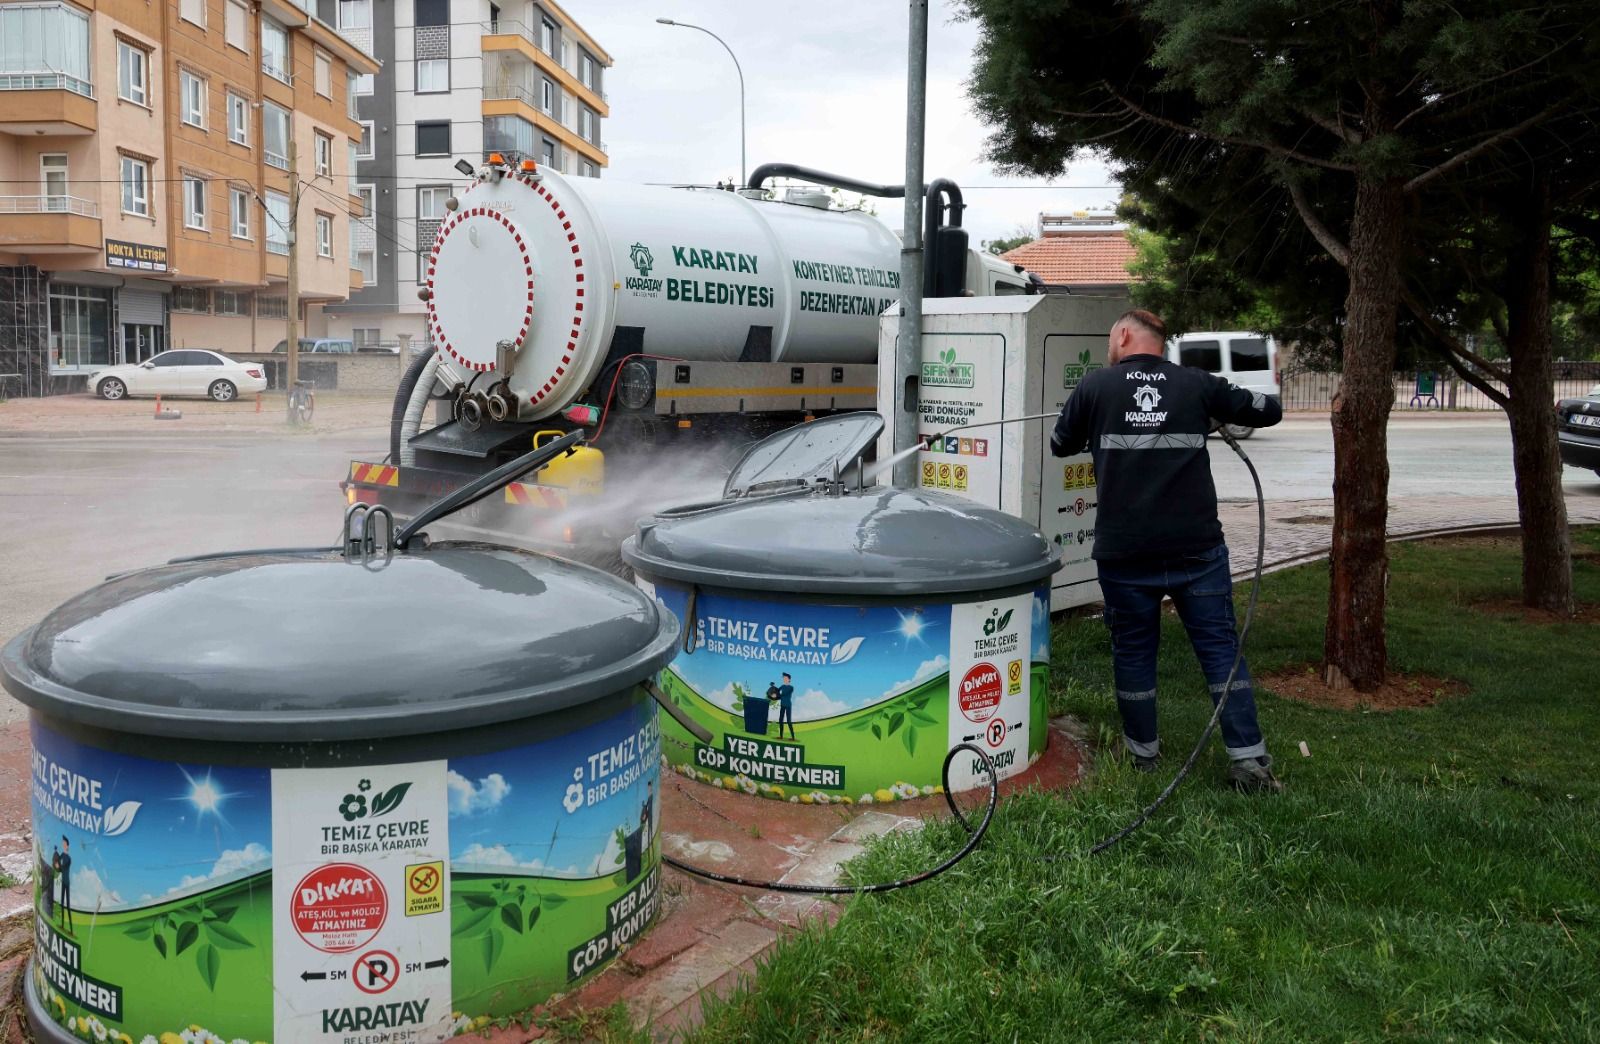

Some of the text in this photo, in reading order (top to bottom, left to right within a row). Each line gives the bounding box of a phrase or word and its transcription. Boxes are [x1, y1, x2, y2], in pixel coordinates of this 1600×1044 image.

[108, 243, 134, 258] NOKTA
[672, 245, 758, 275] KARATAY
[792, 259, 855, 285] KONTEYNER
[625, 276, 663, 292] KARATAY
[800, 290, 875, 316] DEZENFEKTAN
[1126, 371, 1167, 381] KONYA
[924, 414, 969, 425] KUMBARASI
[1125, 411, 1168, 422] KARATAY
[764, 624, 830, 648] ÇEVRE
[727, 643, 767, 661] BAŞKA
[770, 648, 829, 665] KARATAY
[698, 747, 726, 768] ÇÖP
[727, 736, 801, 763] YER ALTI
[49, 762, 103, 811] ÇEVRE
[610, 762, 641, 796] BAŞKA
[53, 798, 102, 835] KARATAY
[376, 819, 429, 842] ÇEVRE
[342, 842, 379, 855] BAŞKA
[382, 837, 429, 851] KARATAY
[610, 865, 657, 925] YER ALTI
[351, 906, 381, 917] MOLOZ
[408, 902, 440, 912] ATMAYIN
[312, 918, 367, 931] ATMAYINIZ
[51, 933, 78, 970] ALTI
[572, 938, 609, 977] ÇÖP
[330, 970, 347, 980] 5M
[405, 962, 422, 973] 5M
[322, 997, 430, 1034] KARATAY
